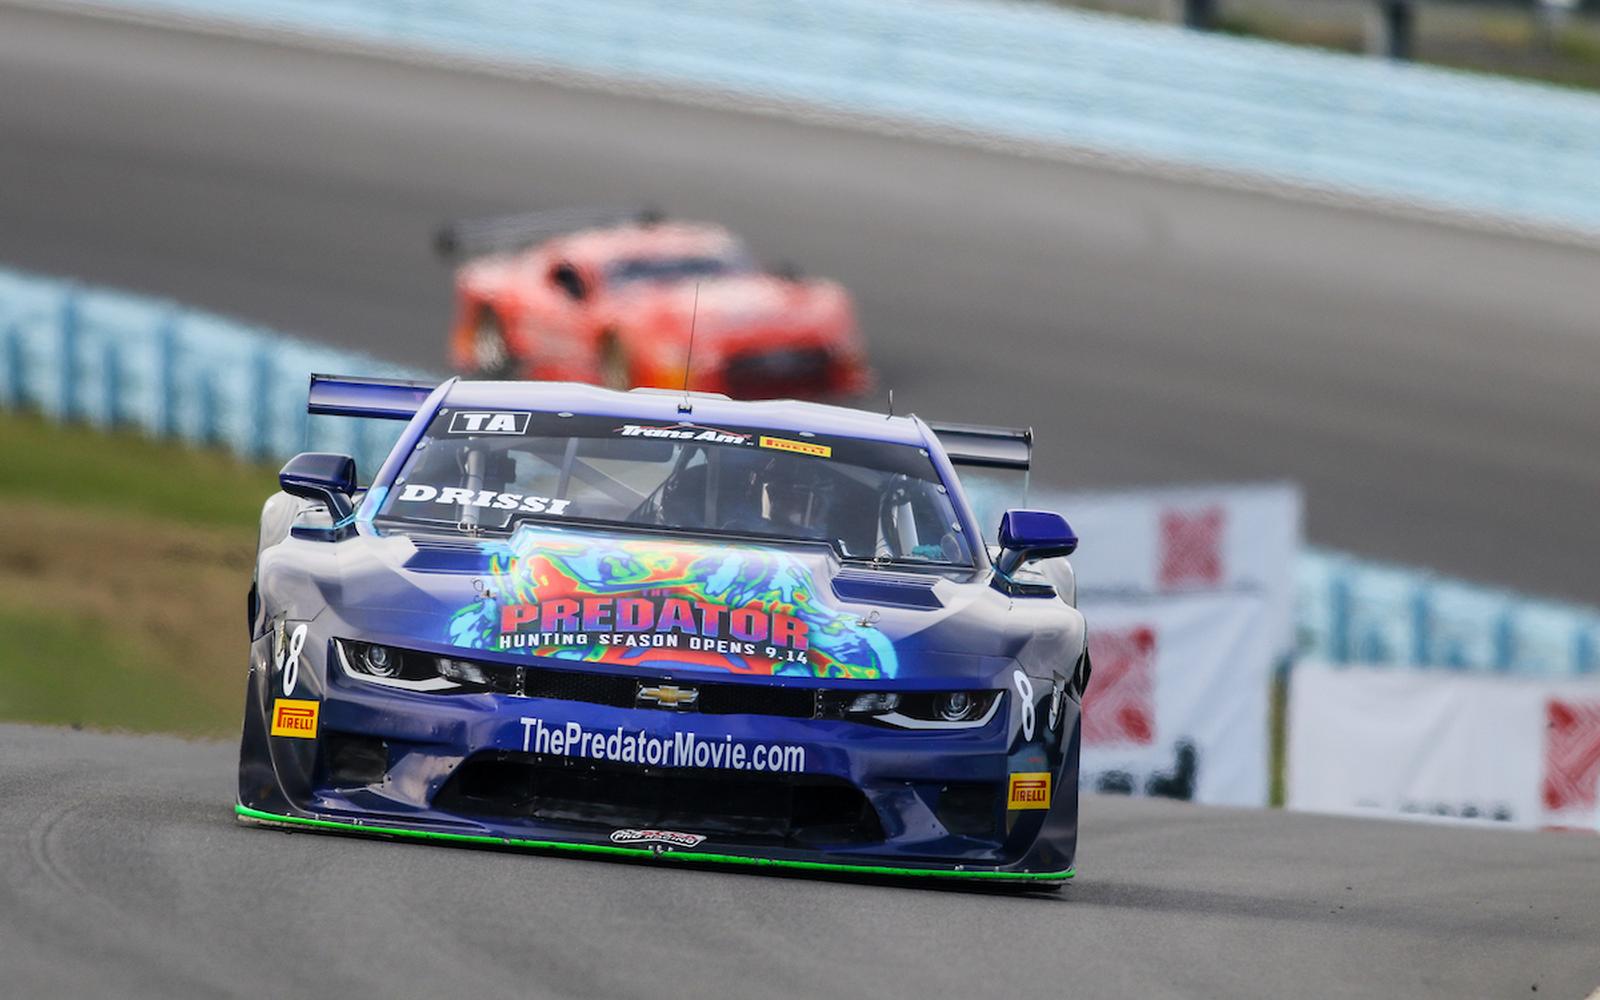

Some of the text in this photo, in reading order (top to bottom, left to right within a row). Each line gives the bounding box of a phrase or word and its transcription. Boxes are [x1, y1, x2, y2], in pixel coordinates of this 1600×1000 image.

[463, 413, 516, 431] TA
[621, 425, 695, 439] Trans
[693, 431, 745, 444] Am
[398, 484, 571, 515] DRISSI
[500, 597, 810, 650] PREDATOR
[283, 623, 308, 697] 8
[500, 632, 809, 665] HUNTING SEASON OPENS 9.14
[276, 706, 315, 730] PIRELLI
[1013, 669, 1036, 742] 8
[520, 717, 806, 772] ThePredatorMovie.com
[1011, 780, 1047, 802] PIRELLI
